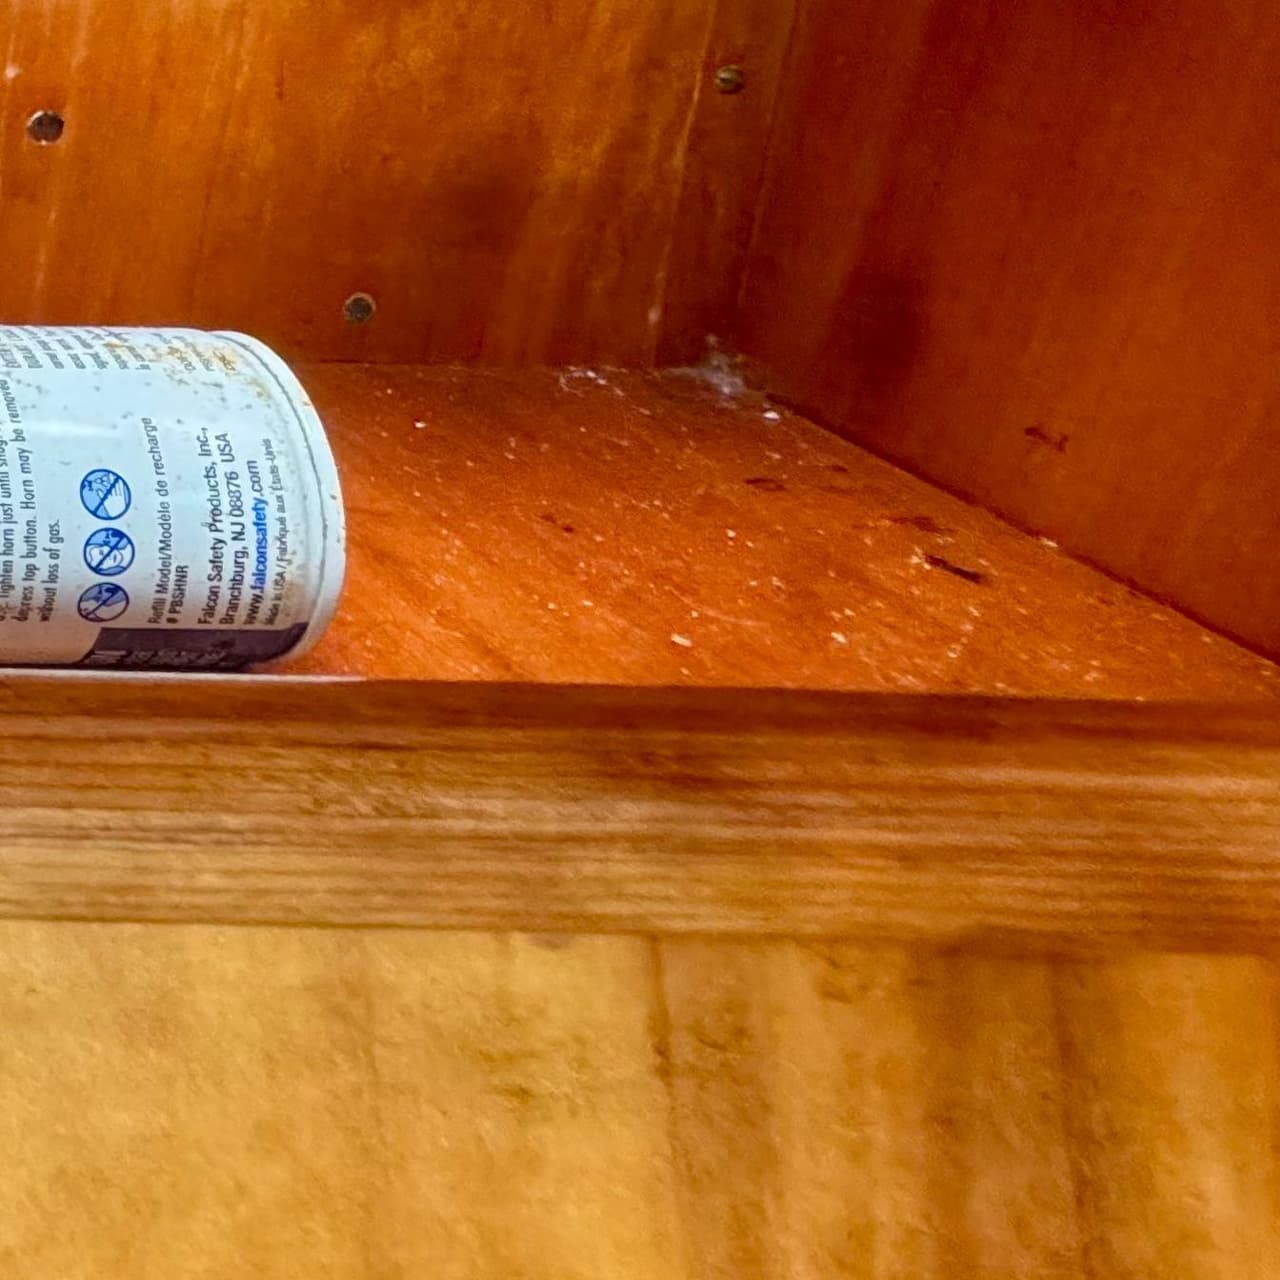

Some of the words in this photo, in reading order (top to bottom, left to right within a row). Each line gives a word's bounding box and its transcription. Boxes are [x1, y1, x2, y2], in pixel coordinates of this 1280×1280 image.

[9, 428, 27, 443] be
[140, 417, 167, 476] recharge
[213, 432, 236, 463] USA
[15, 446, 33, 475] may
[18, 479, 36, 510] Horn
[154, 479, 170, 497] de
[203, 460, 225, 533] Products,
[224, 470, 245, 518] 08876
[18, 516, 38, 559] button.
[48, 518, 65, 544] gas.
[228, 520, 246, 542] NJ
[241, 459, 270, 625] www.falconsafety.com
[42, 546, 61, 561] of
[207, 537, 229, 583] Safety
[21, 563, 41, 582] top
[40, 563, 60, 584] loss
[218, 545, 251, 625] Branchburg,
[197, 584, 221, 625] Falcon
